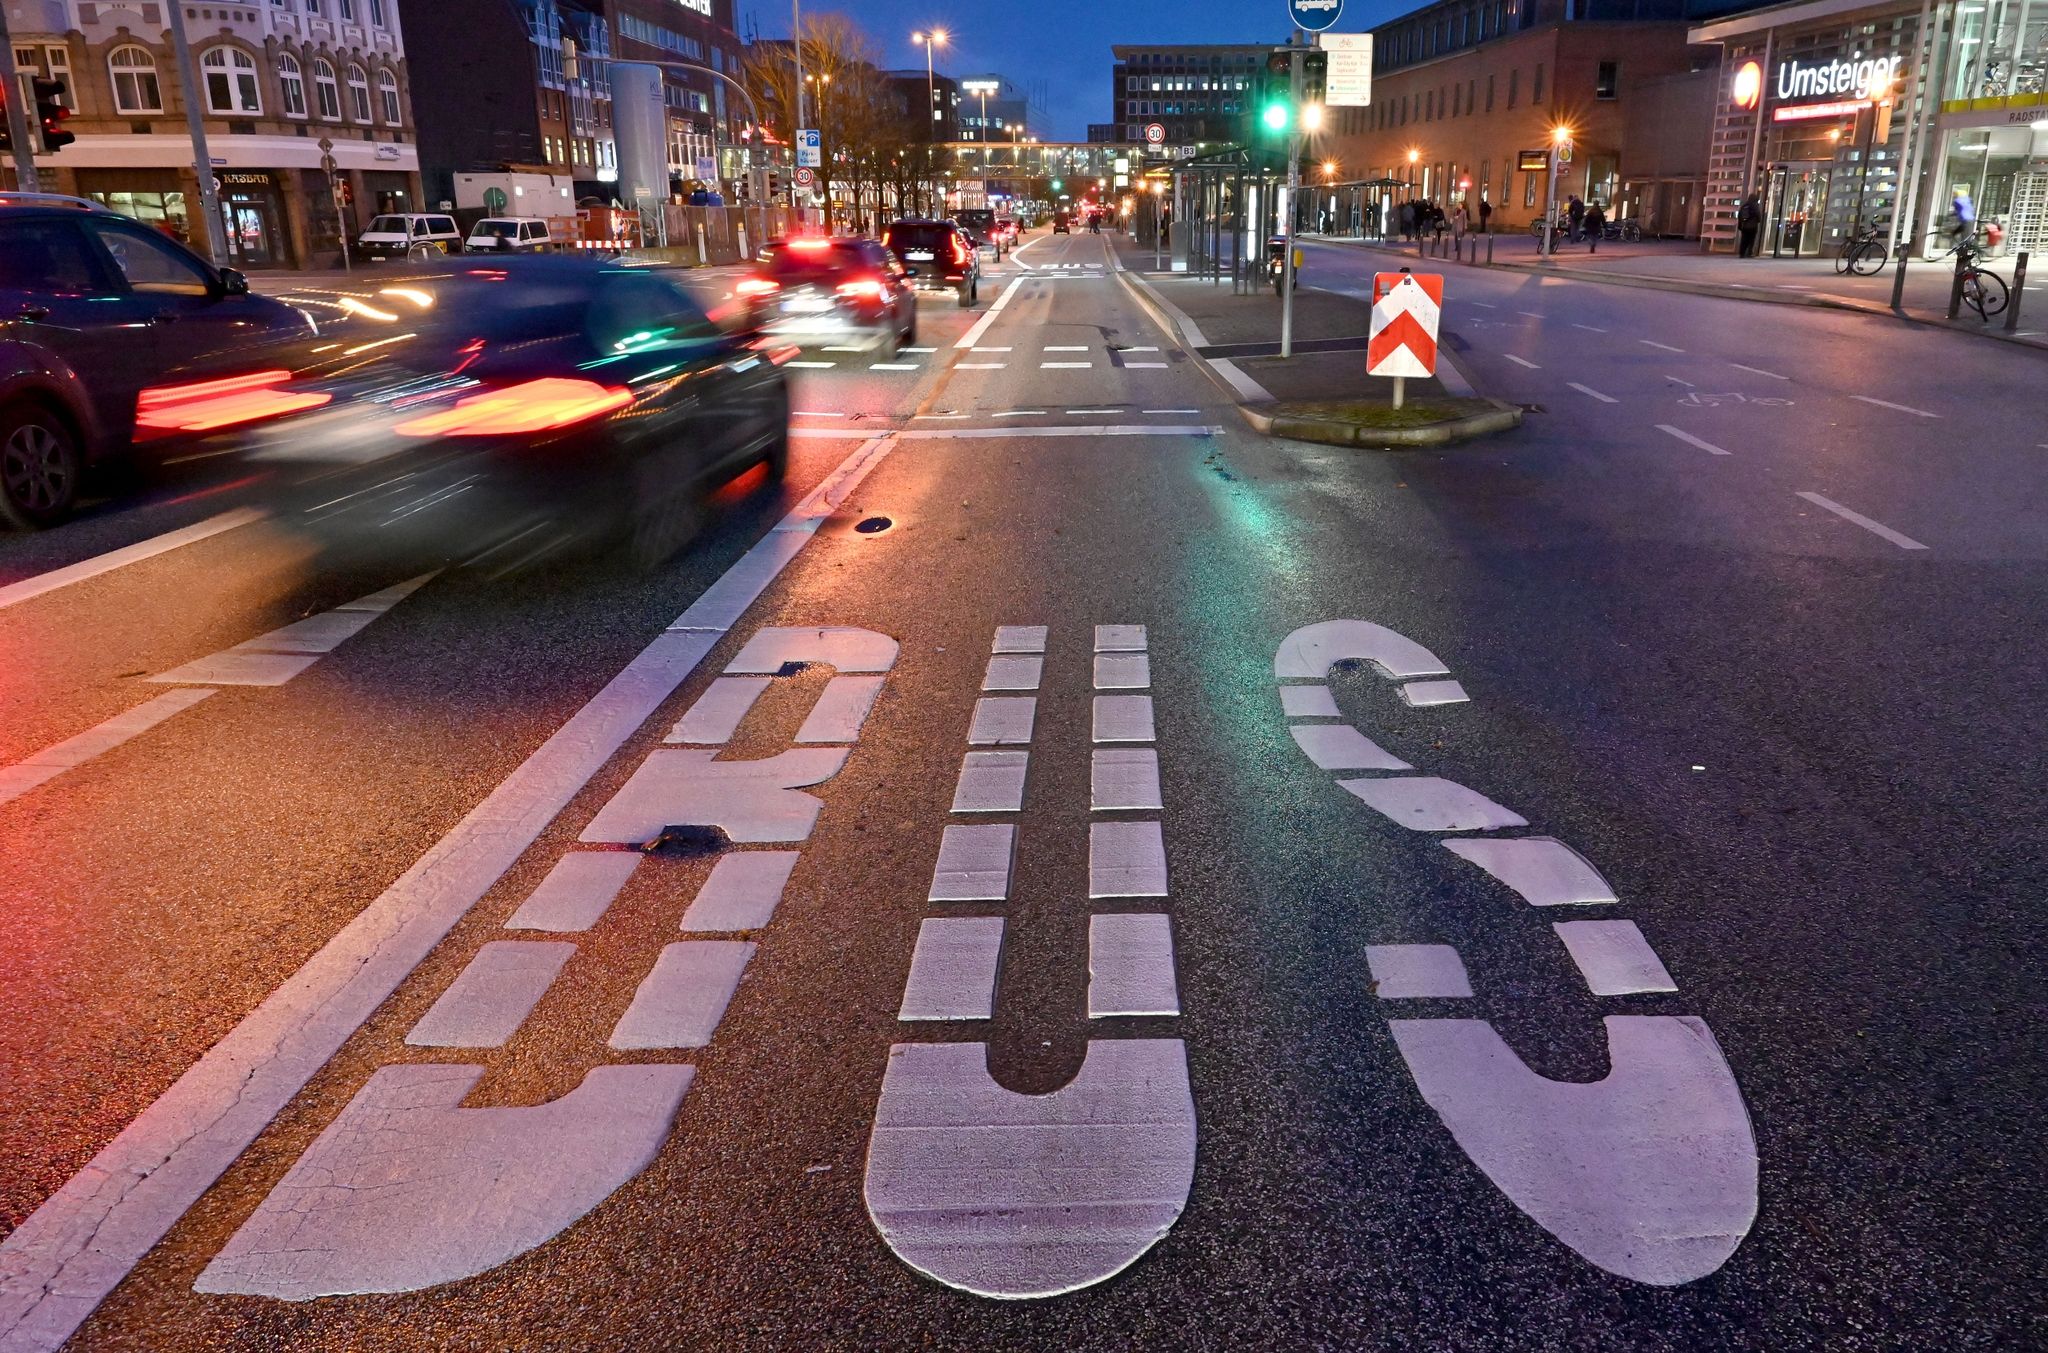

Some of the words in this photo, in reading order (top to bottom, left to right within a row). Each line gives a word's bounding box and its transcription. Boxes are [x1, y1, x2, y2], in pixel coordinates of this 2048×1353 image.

[1778, 51, 1902, 99] Umsteiger
[2008, 110, 2048, 123] RADSTA
[1150, 130, 1160, 138] 30
[800, 172, 809, 181] 30
[193, 619, 1759, 1301] BUS
